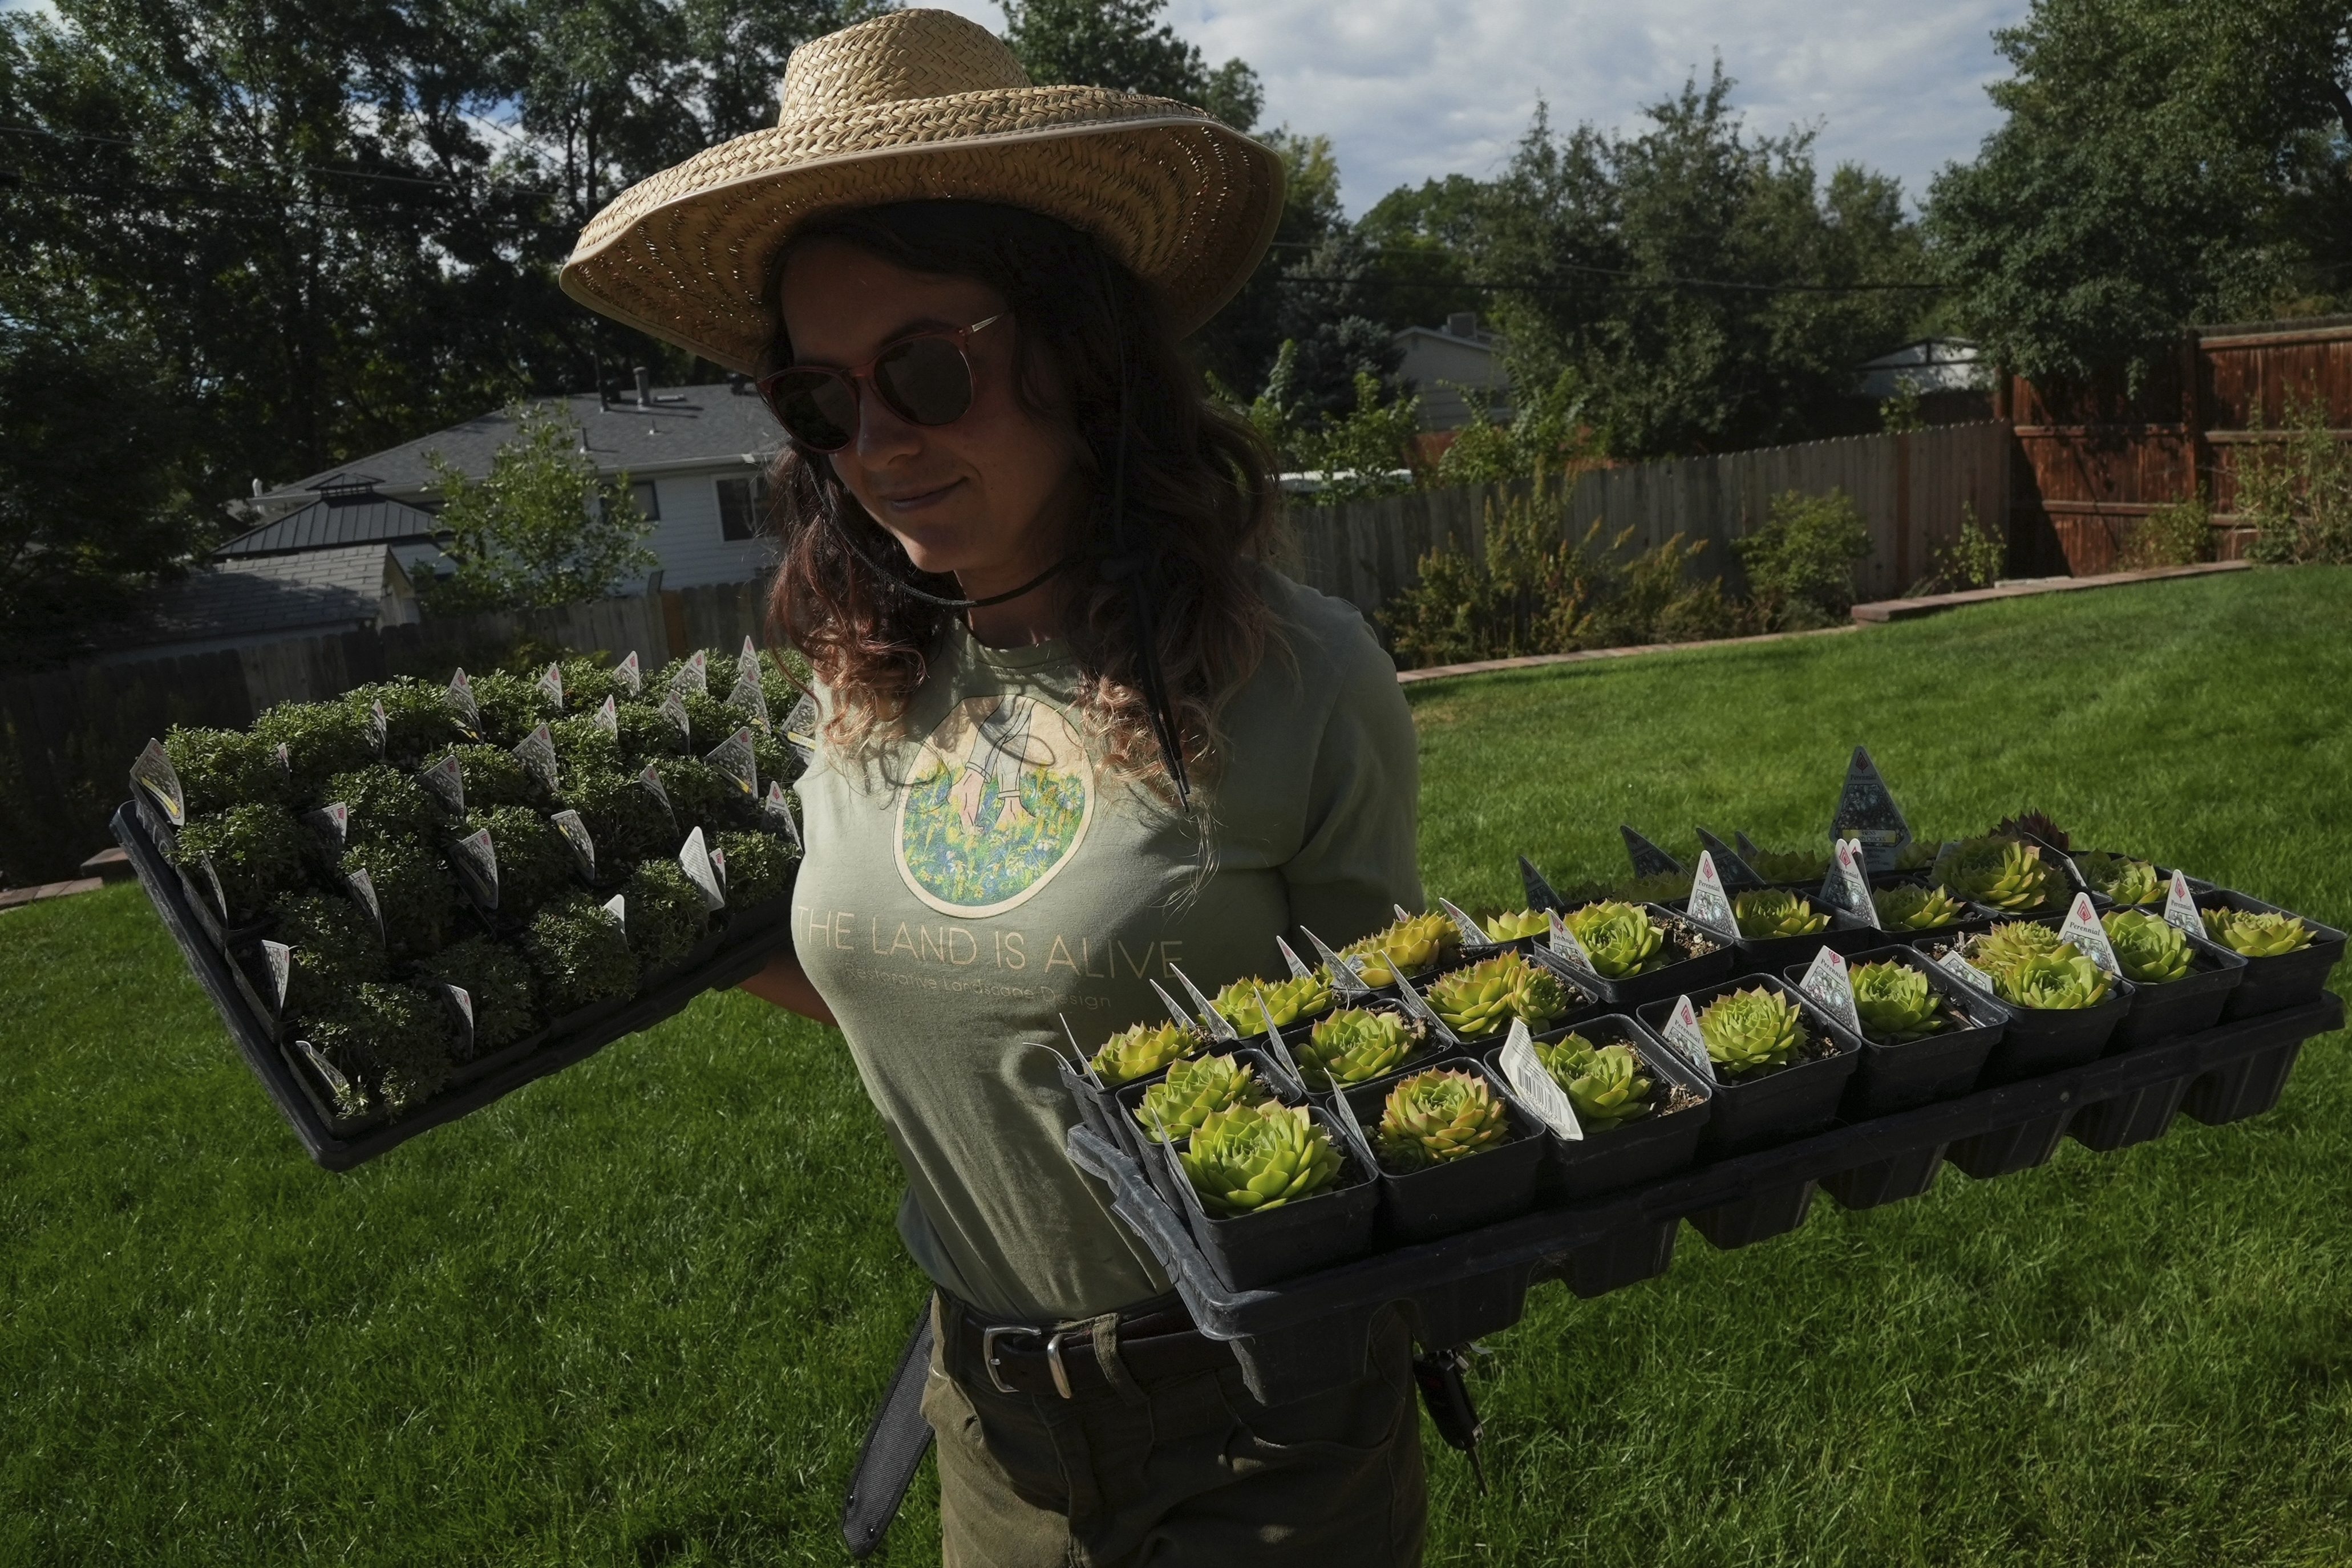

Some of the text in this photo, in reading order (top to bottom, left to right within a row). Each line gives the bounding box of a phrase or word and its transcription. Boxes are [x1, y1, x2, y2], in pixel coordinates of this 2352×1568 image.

[1835, 865, 1859, 880] Perennial
[1698, 880, 1721, 892] Perennial
[2171, 899, 2192, 911] Perennial
[2069, 921, 2101, 937] Perennial
[798, 905, 1183, 979] THE LAND IS ALIVE
[1820, 958, 1847, 983] Perennial
[1041, 986, 1111, 1010] Design
[1674, 1019, 1701, 1044] Perennial
